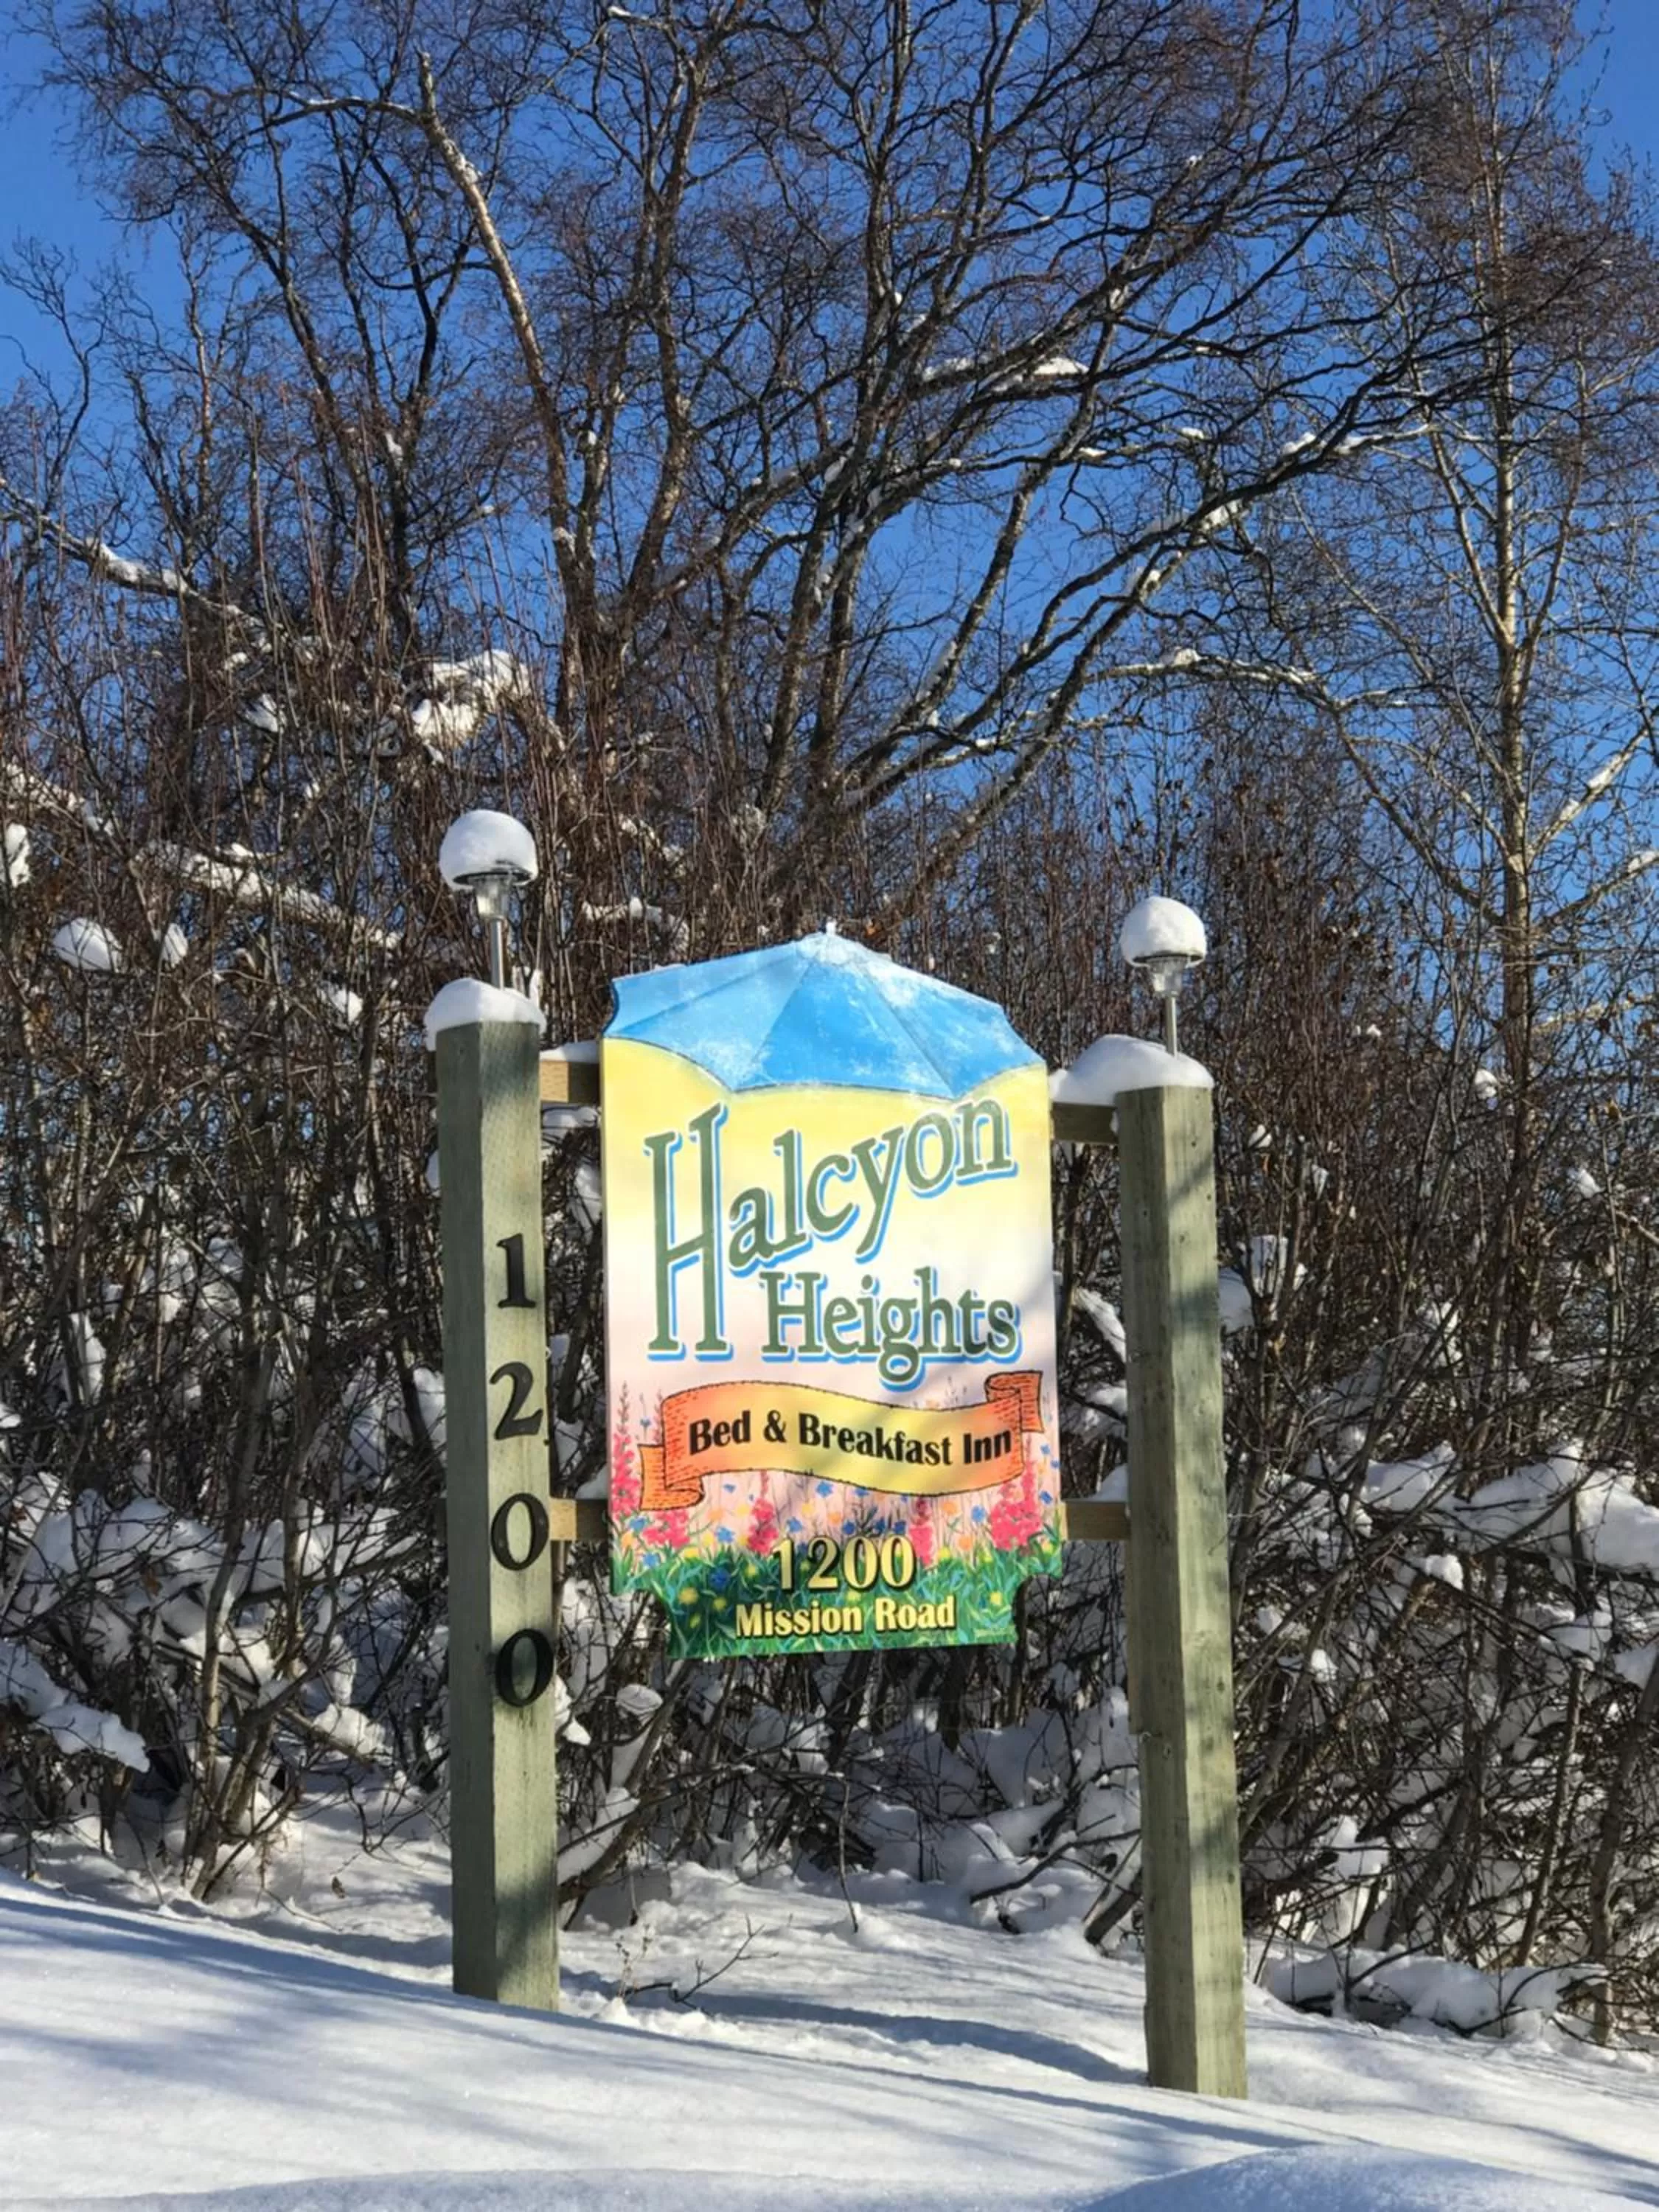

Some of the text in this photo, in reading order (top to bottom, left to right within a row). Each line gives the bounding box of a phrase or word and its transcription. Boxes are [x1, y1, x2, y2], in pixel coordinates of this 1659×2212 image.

[643, 1099, 1018, 1360] Halcyon
[759, 1266, 1022, 1391] Heights
[490, 1233, 556, 1708] 1200
[689, 1410, 1012, 1466] Bed & Breakfast Inn
[773, 1536, 917, 1591] 1200
[737, 1596, 956, 1638] Mission Road
